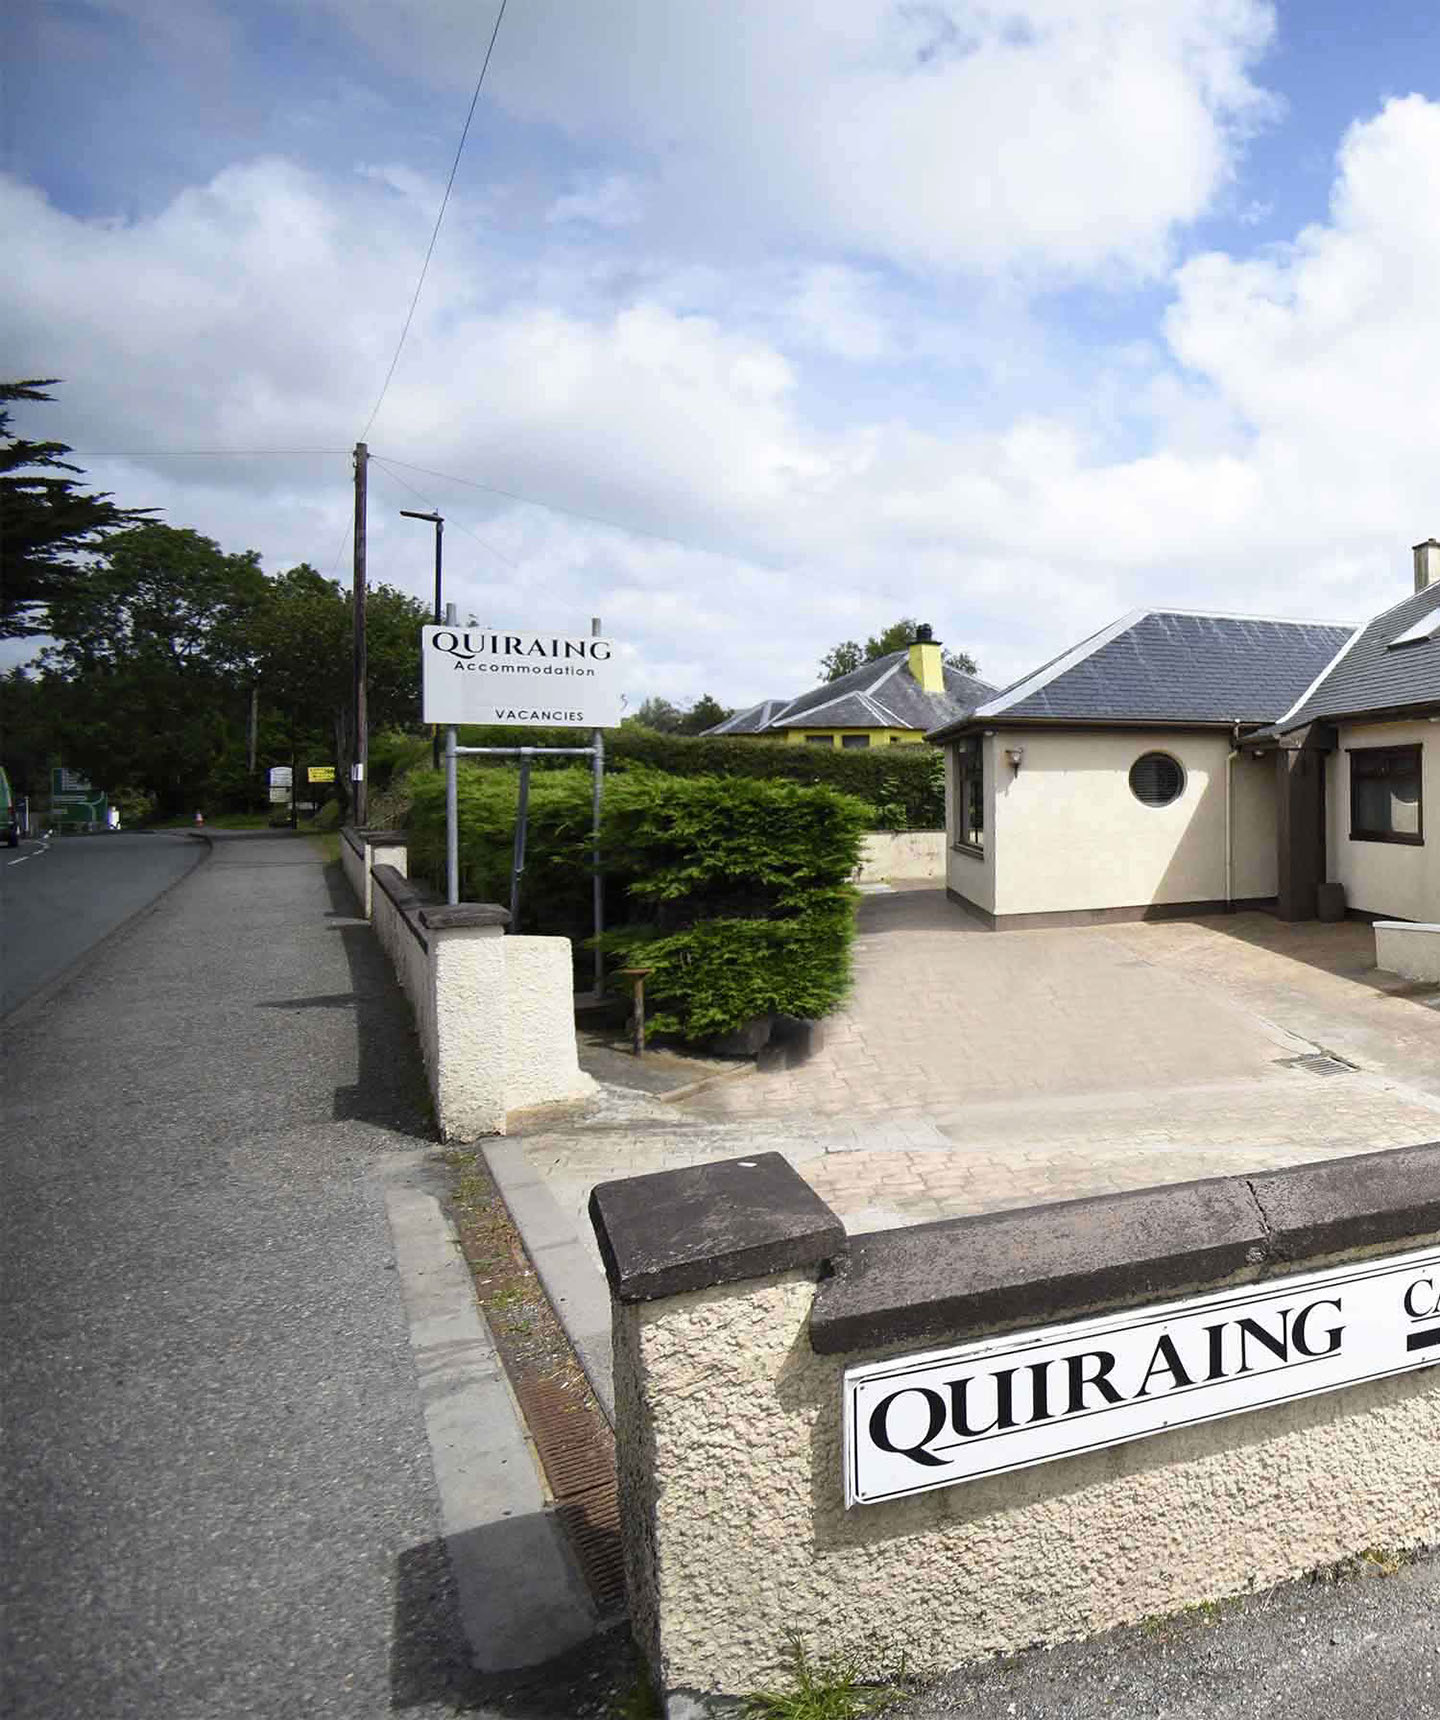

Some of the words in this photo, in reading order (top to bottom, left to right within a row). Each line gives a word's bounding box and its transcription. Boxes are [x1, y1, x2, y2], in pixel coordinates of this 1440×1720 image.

[432, 631, 611, 660] QUIRAING
[454, 660, 595, 677] Accommodation
[495, 709, 584, 721] VACANCIES
[868, 1298, 1345, 1467] QUIRAING
